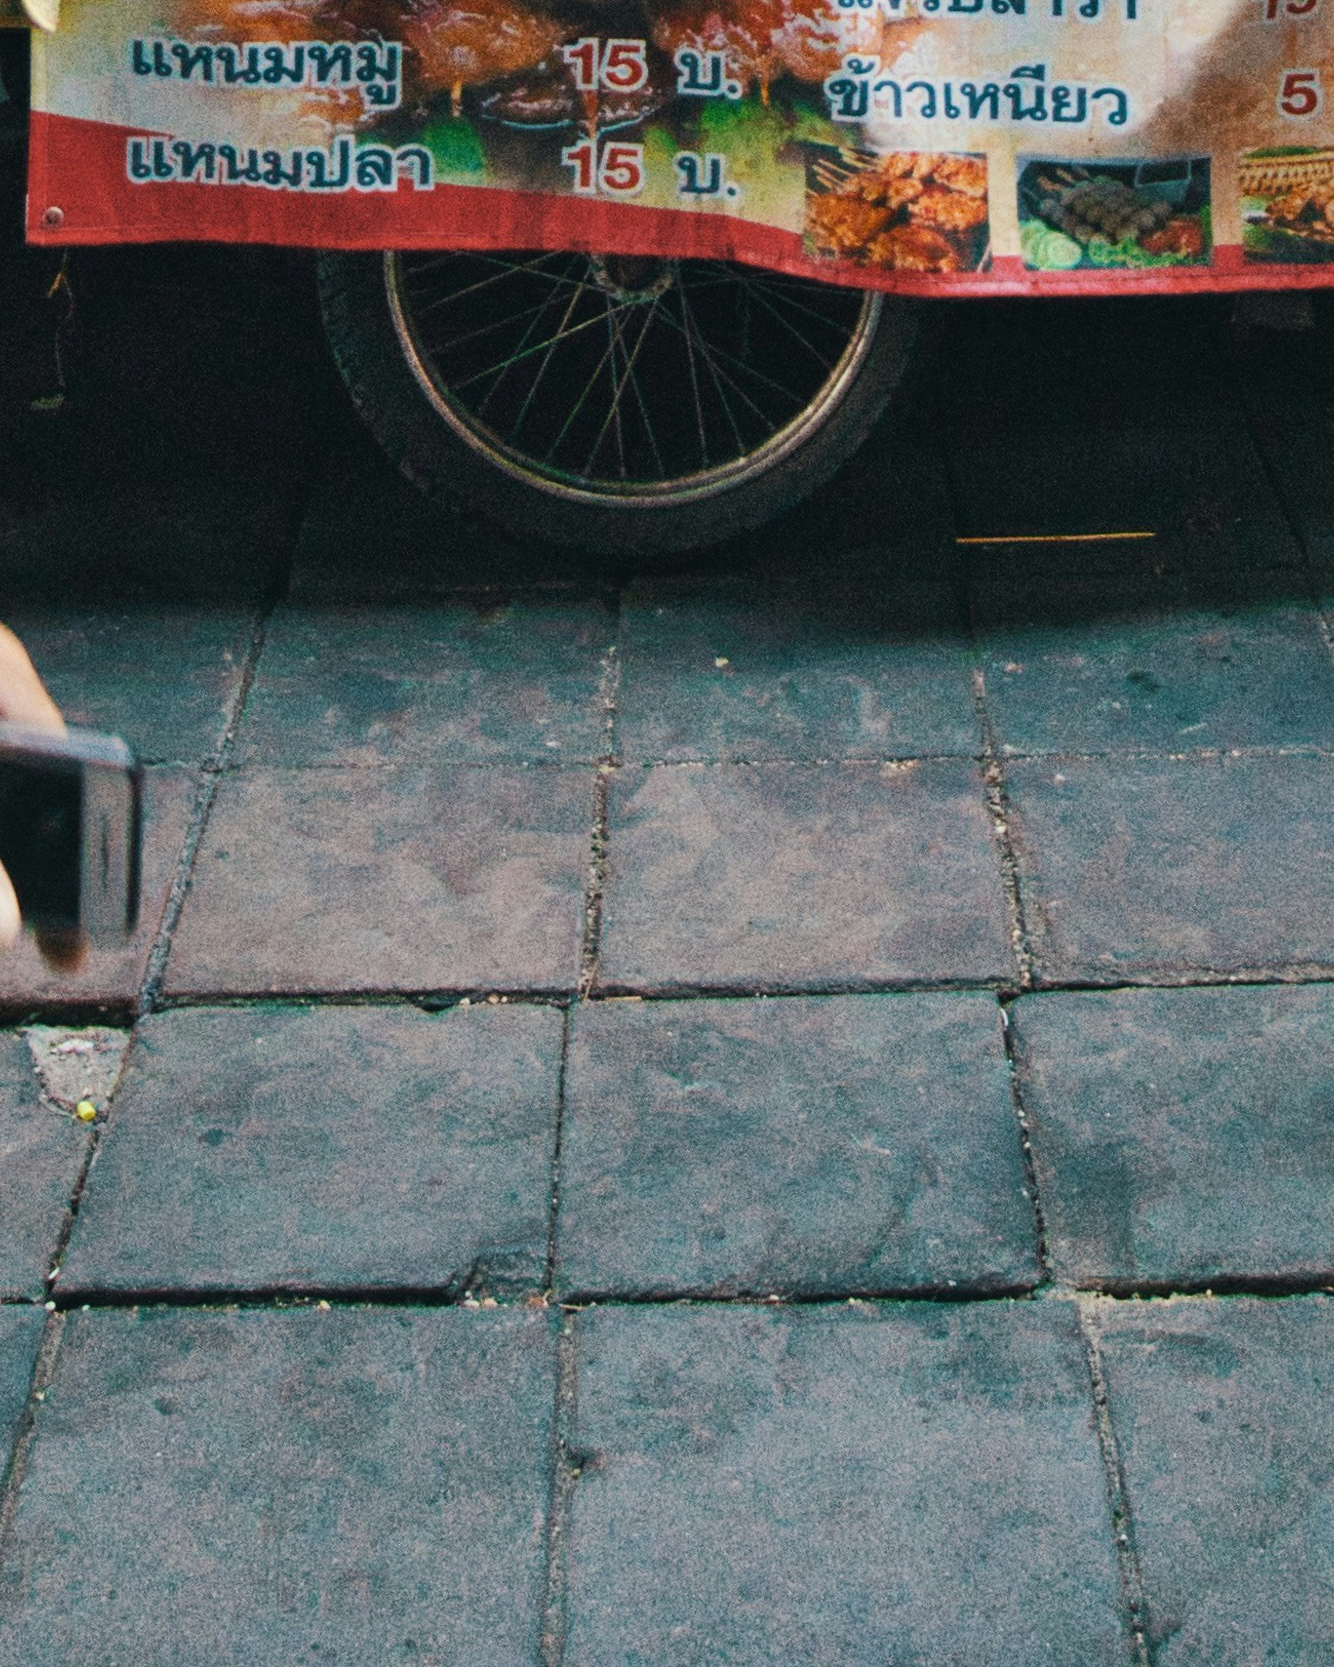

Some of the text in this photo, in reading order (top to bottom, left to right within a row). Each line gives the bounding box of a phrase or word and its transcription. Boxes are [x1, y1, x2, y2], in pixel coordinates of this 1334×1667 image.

[132, 38, 739, 105] แหนมหมู 15 บ.
[828, 57, 1128, 125] ข้าวเหนียว
[1281, 73, 1318, 116] 5
[131, 138, 737, 197] แหนมปลา 15 บ.
